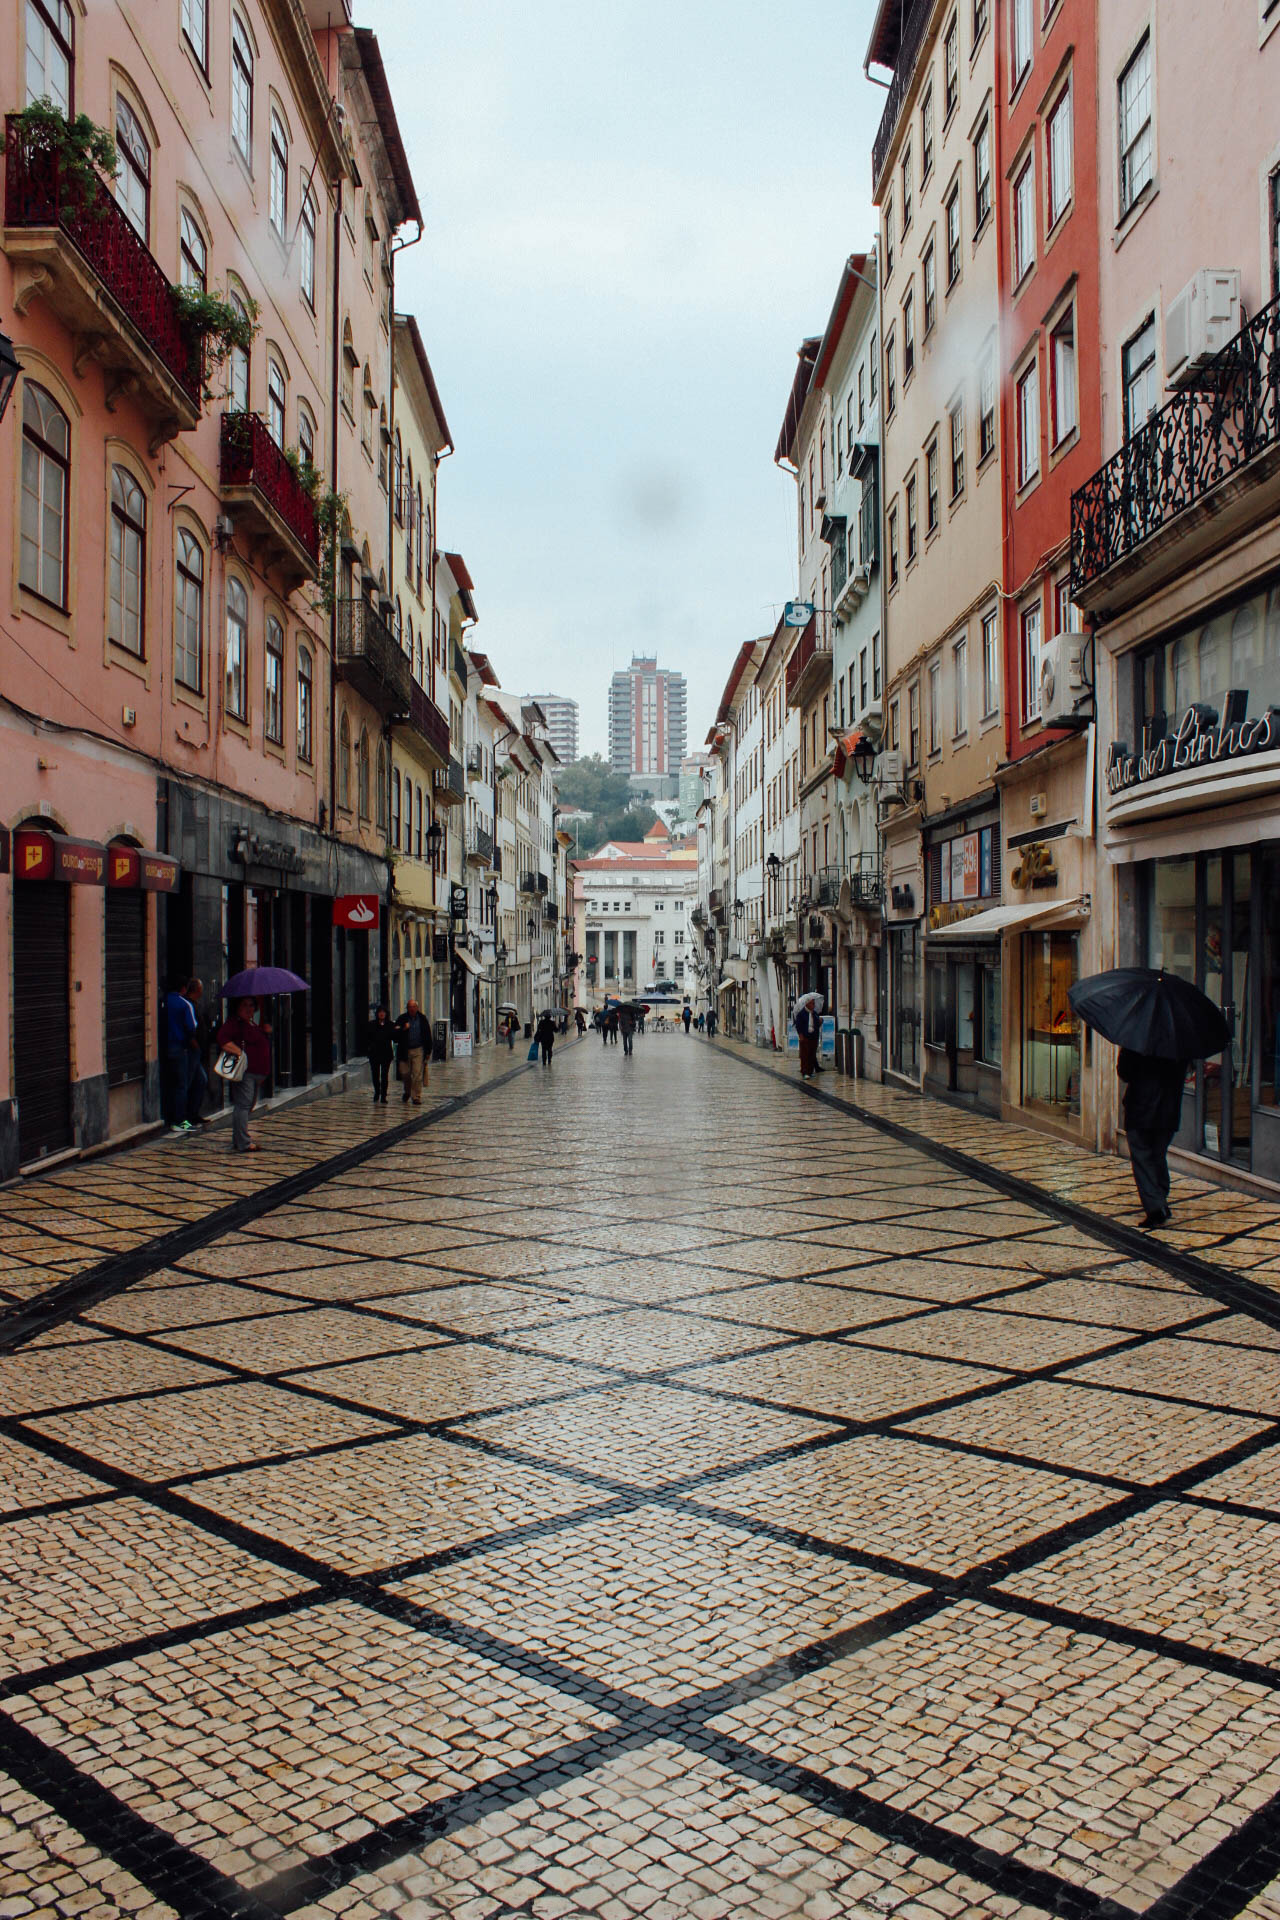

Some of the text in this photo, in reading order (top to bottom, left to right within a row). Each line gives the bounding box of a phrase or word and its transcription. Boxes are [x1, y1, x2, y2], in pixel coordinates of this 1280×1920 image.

[1138, 724, 1168, 781] dos
[1172, 690, 1274, 767] Linhos
[62, 853, 78, 869] OURO
[84, 857, 97, 871] PESO
